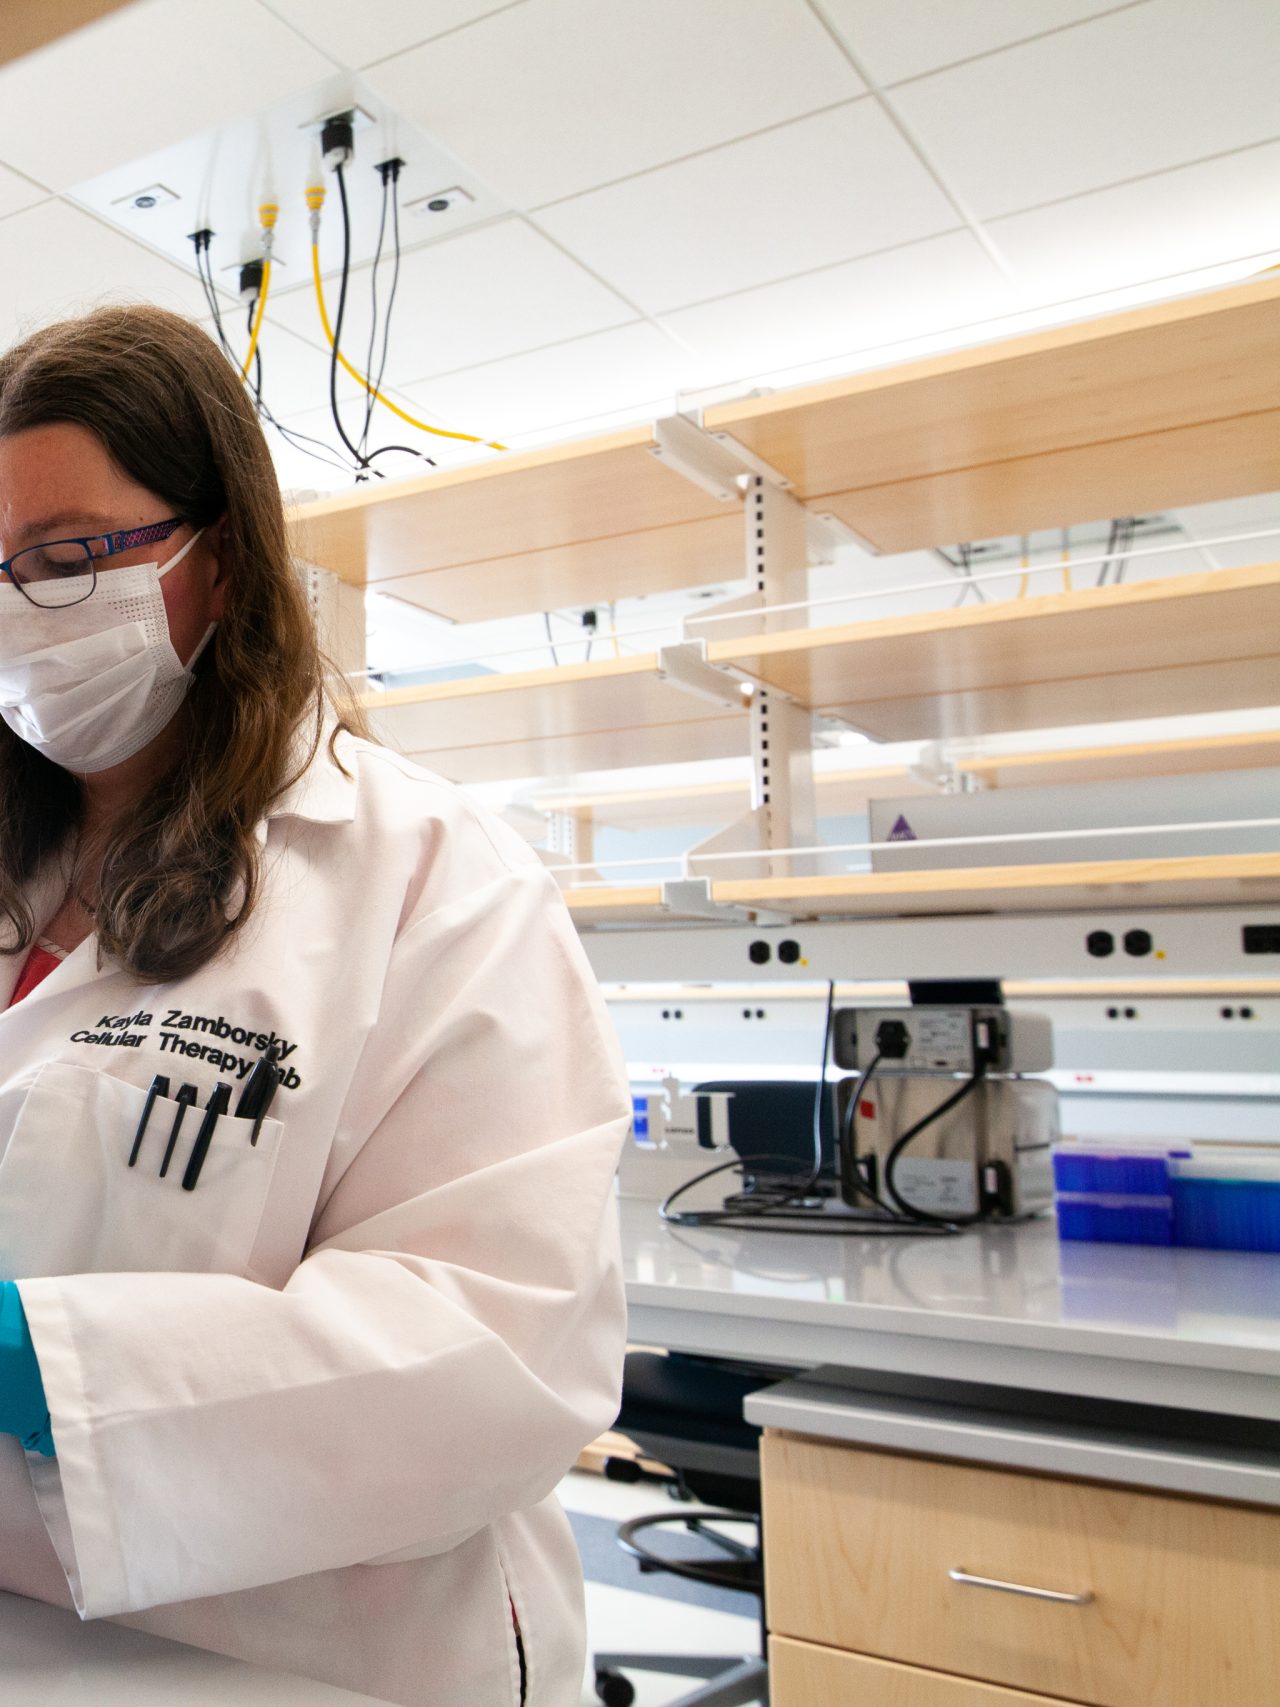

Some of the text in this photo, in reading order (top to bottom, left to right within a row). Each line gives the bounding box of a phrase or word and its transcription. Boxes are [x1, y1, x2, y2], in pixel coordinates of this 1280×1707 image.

[69, 1030, 148, 1048] Cellular
[158, 1032, 254, 1079] Therapy
[96, 1010, 297, 1061] Kayla Zamborsky
